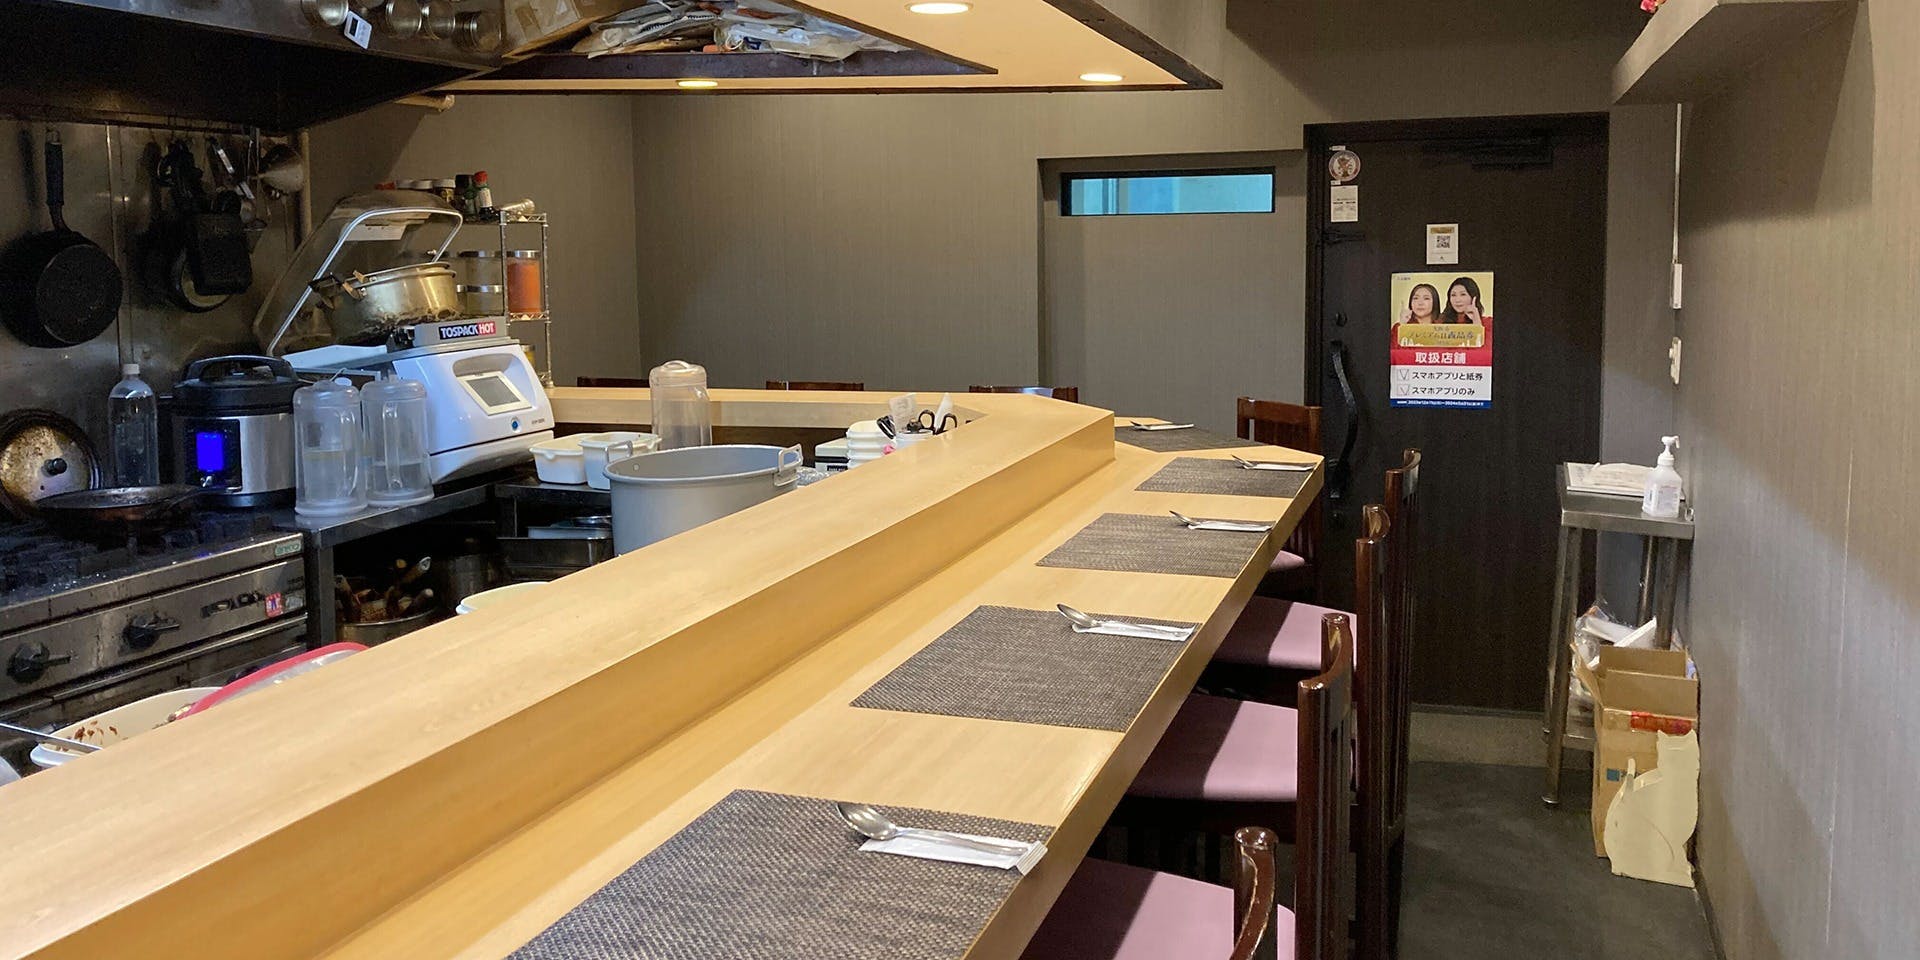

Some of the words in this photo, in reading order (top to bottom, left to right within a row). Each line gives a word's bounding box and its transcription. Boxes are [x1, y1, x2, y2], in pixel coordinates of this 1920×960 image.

[441, 324, 478, 338] TOSPACK
[479, 322, 495, 334] HOT
[1415, 352, 1466, 364] 取扱店舗
[1412, 371, 1483, 381] スマホアプリと紙券
[1412, 386, 1475, 396] スマホアプリのみ
